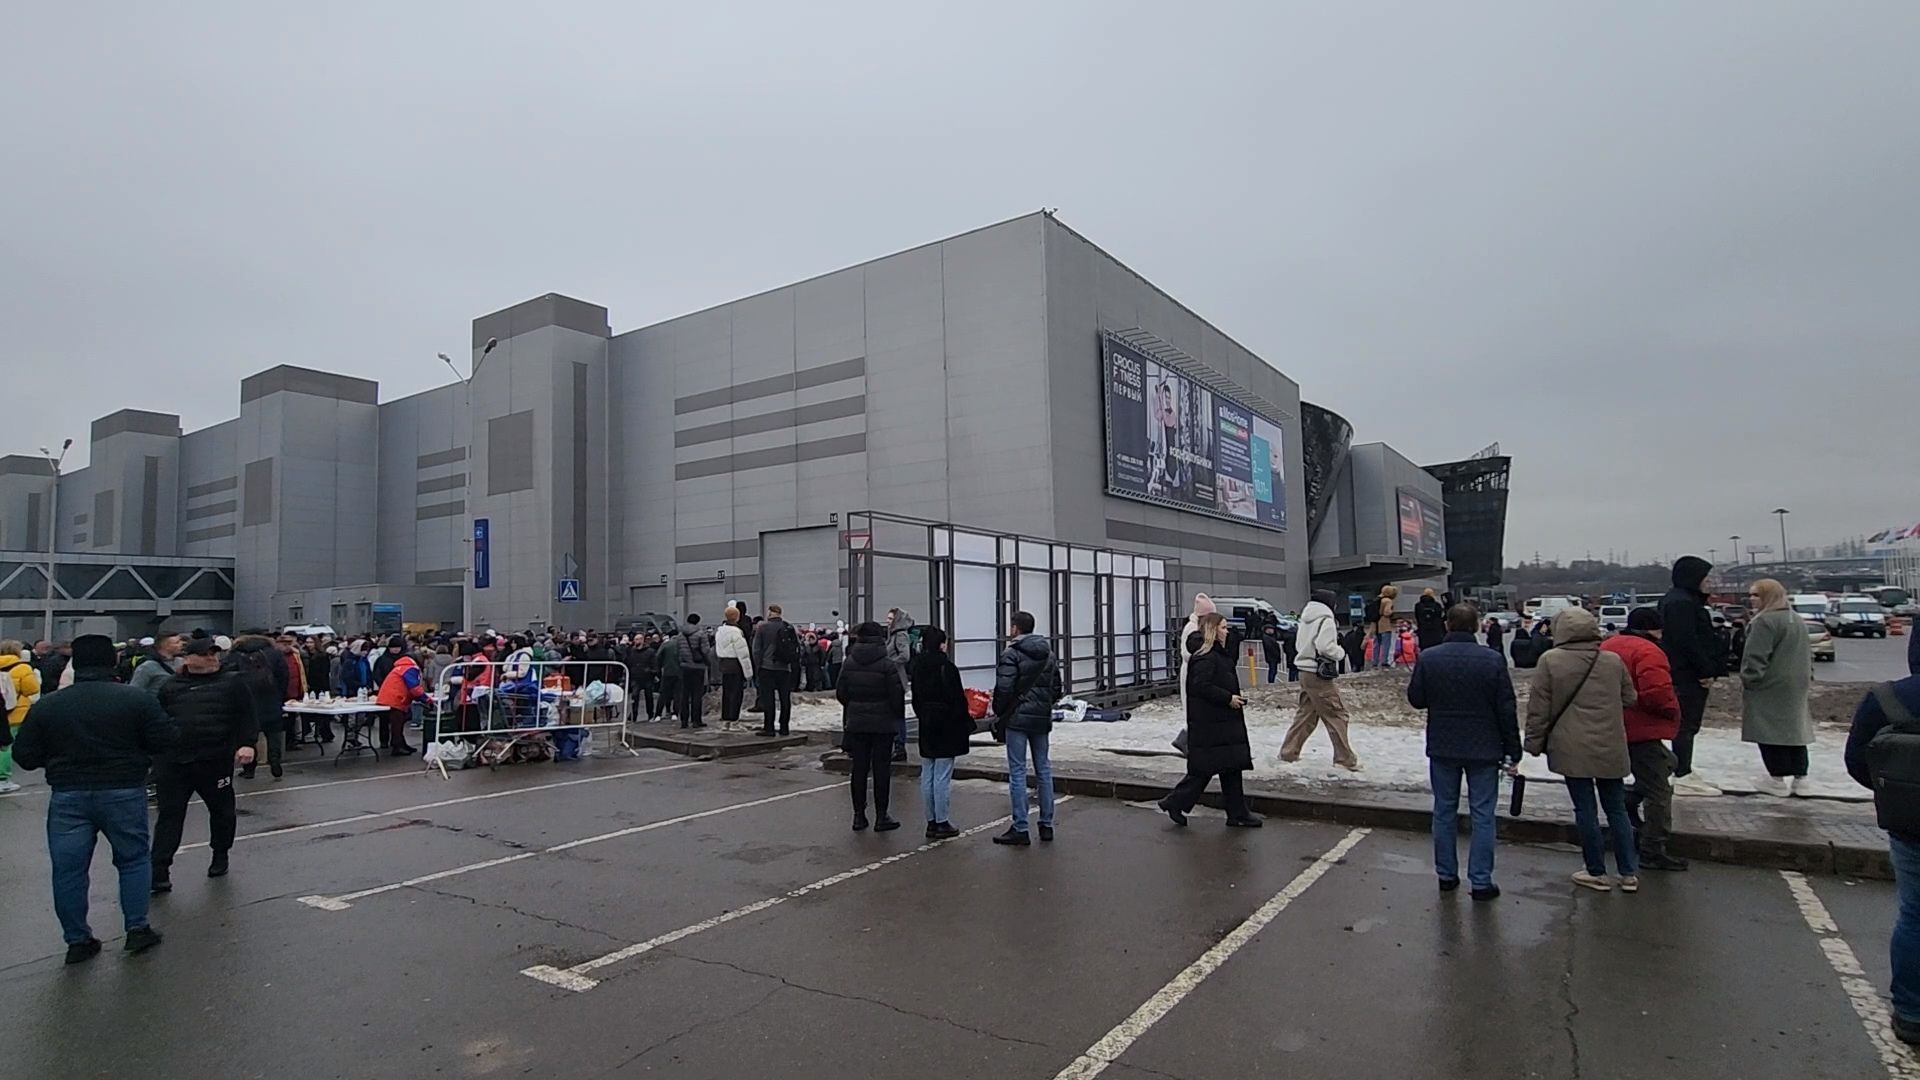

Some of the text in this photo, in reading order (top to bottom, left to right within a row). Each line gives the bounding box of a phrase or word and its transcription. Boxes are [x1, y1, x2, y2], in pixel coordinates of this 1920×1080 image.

[1113, 353, 1141, 375] CROCUS
[1113, 366, 1141, 388] FTNESS
[1113, 381, 1142, 403] ПЕРВЫЙ
[217, 776, 231, 789] 23
